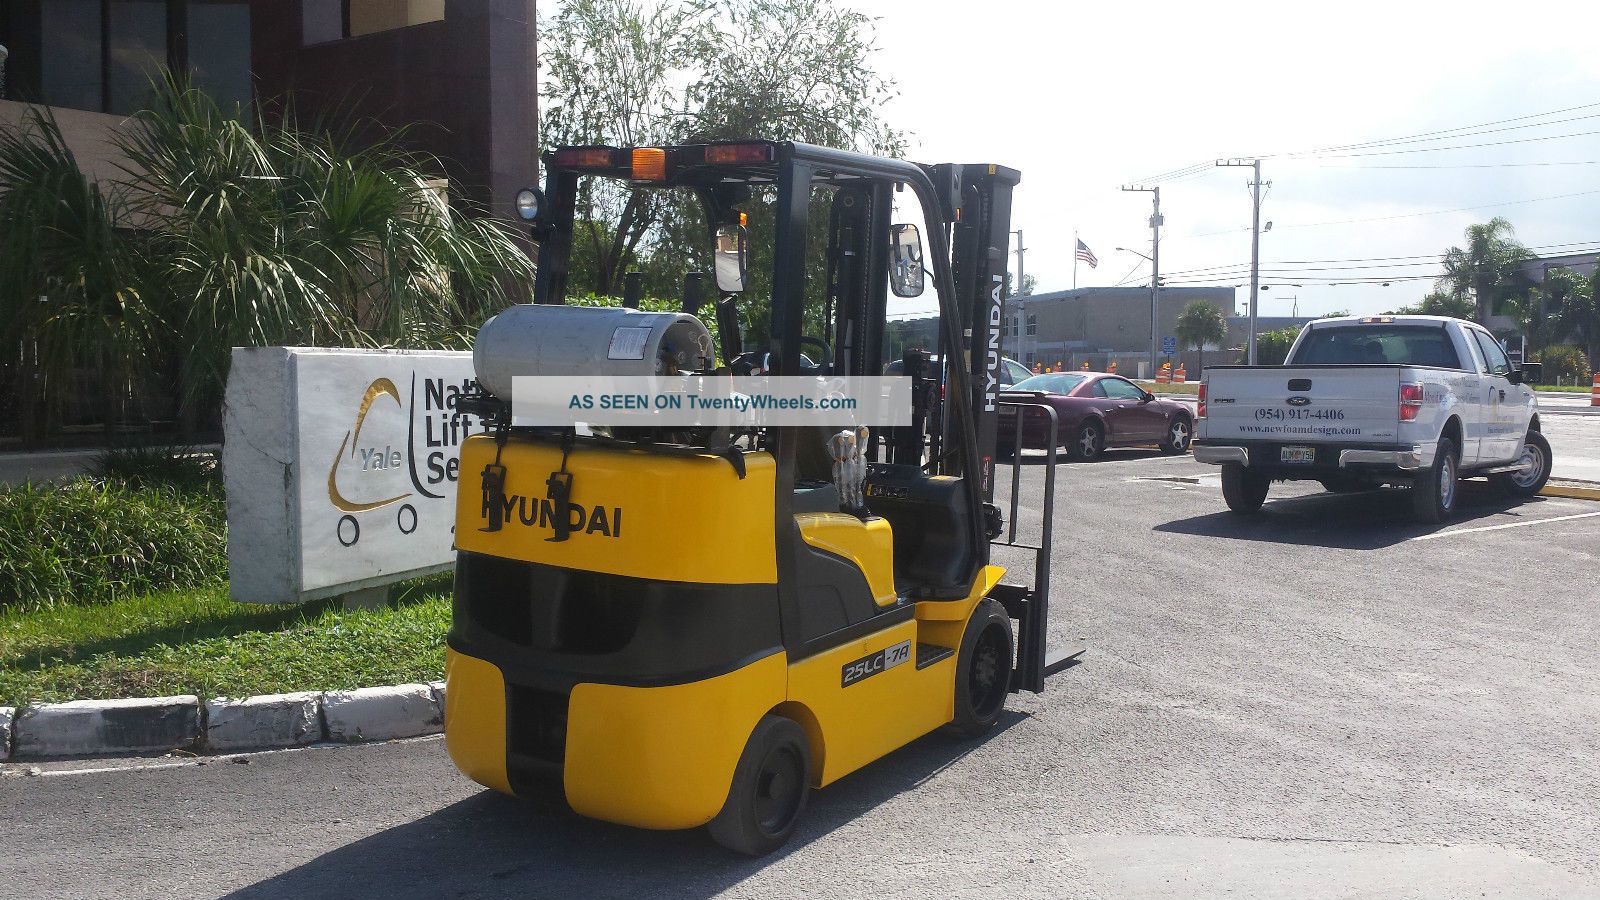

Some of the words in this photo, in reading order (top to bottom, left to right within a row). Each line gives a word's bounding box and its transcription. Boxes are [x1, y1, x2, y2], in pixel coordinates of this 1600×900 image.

[984, 274, 1003, 412] HYUNDAI
[1255, 408, 1285, 420] (954)
[1288, 409, 1344, 420] 917-4406
[425, 413, 472, 447] Lift
[1239, 424, 1361, 436] www.newfoamdesign.com
[360, 445, 402, 472] Yale
[427, 451, 460, 484] Se
